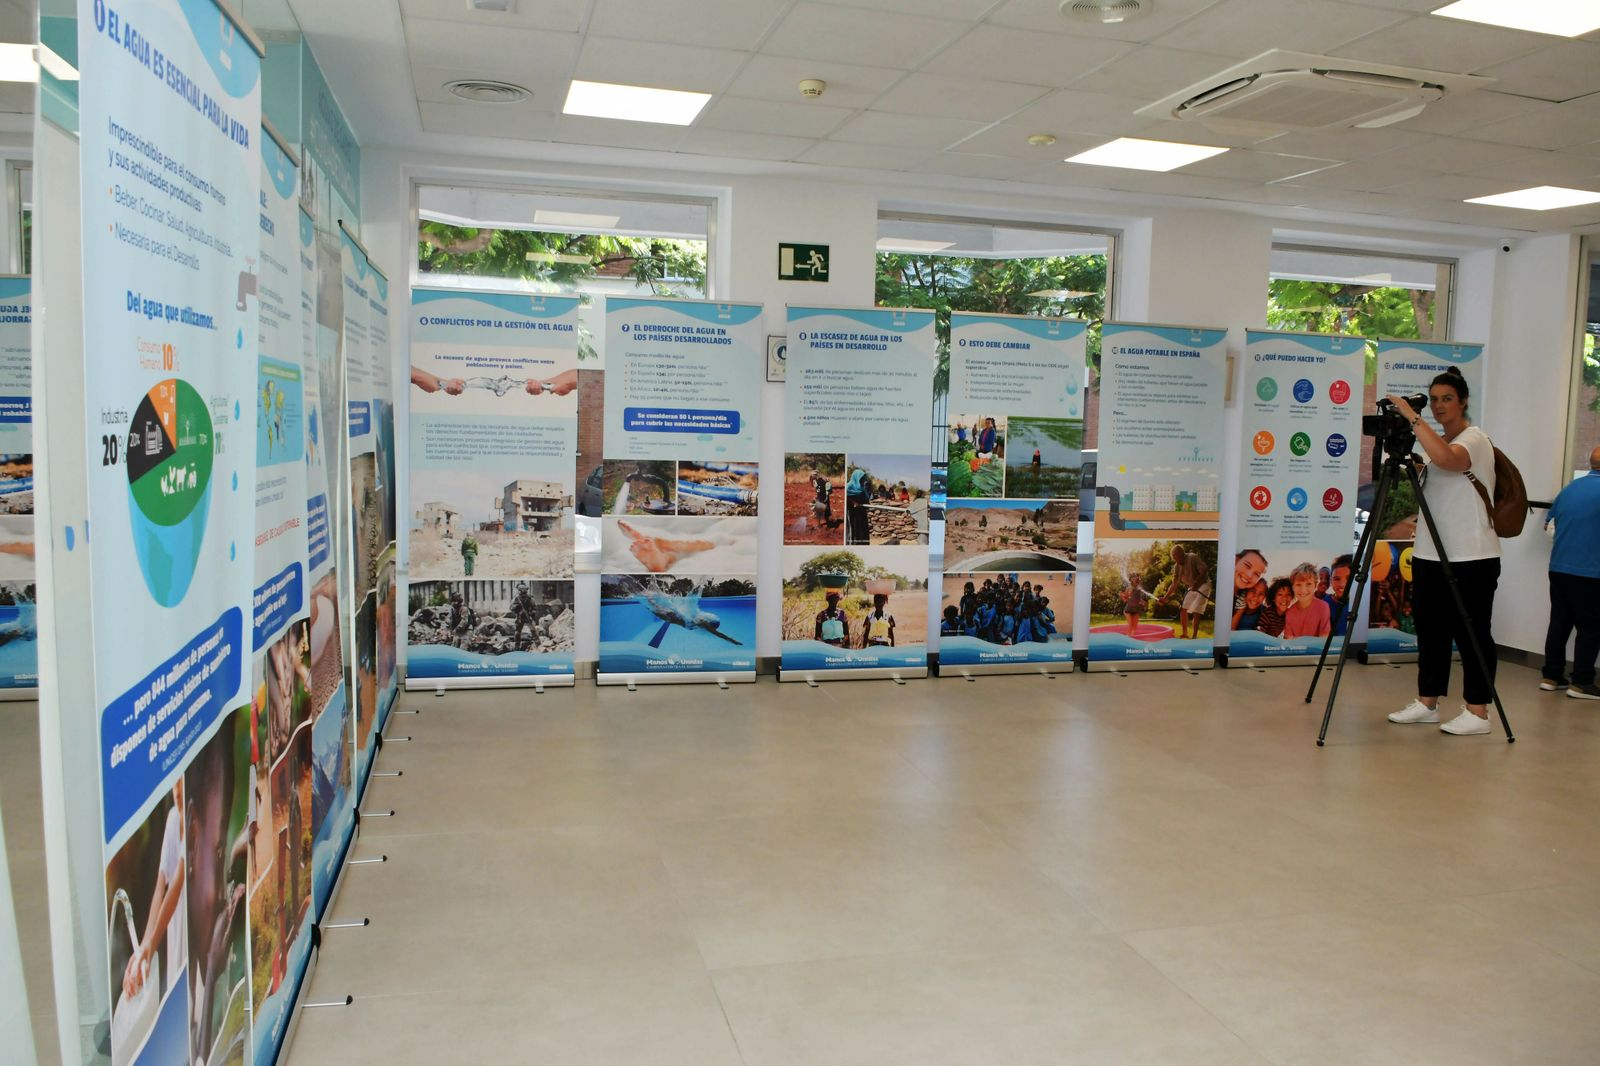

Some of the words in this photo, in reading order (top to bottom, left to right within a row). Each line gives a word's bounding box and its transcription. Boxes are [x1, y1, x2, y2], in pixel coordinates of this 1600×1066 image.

[108, 8, 120, 44] EL
[124, 22, 150, 70] AGUA
[154, 48, 164, 80] ES
[166, 60, 201, 112] ESENCIAL
[203, 93, 220, 128] PARA
[222, 110, 228, 136] LA
[231, 118, 249, 149] VIDA
[108, 116, 162, 165] Imprescindible
[164, 155, 177, 174] para
[179, 163, 184, 178] el
[186, 170, 209, 194] consumo
[109, 148, 114, 168] y
[116, 152, 129, 171] sus
[131, 159, 168, 193] actividades
[115, 221, 149, 251] Necesaria
[151, 240, 165, 257] para
[127, 291, 141, 313] Del
[143, 299, 163, 320] agua
[165, 305, 178, 323] que
[430, 317, 474, 326] CONFLICTOS
[505, 320, 536, 329] GESTIÓN
[644, 325, 680, 333] DERROCHE
[649, 334, 672, 342] PAÍSES
[674, 336, 732, 345] DESARROLLADOS
[810, 340, 833, 348] PAÍSES
[845, 343, 887, 351] DESARROLLO
[1003, 341, 1030, 350] CAMBIAR
[1262, 353, 1276, 362] ¿QUÉ
[102, 408, 128, 425] Industria
[102, 434, 127, 466] 20%
[130, 432, 140, 447] 20%
[166, 657, 190, 689] millones
[190, 648, 197, 665] de
[110, 721, 147, 769] disponen
[147, 714, 156, 734] de
[156, 689, 184, 724] servicios
[202, 663, 209, 681] de
[149, 742, 158, 762] de
[158, 726, 175, 754] agua
[176, 712, 188, 738] para
